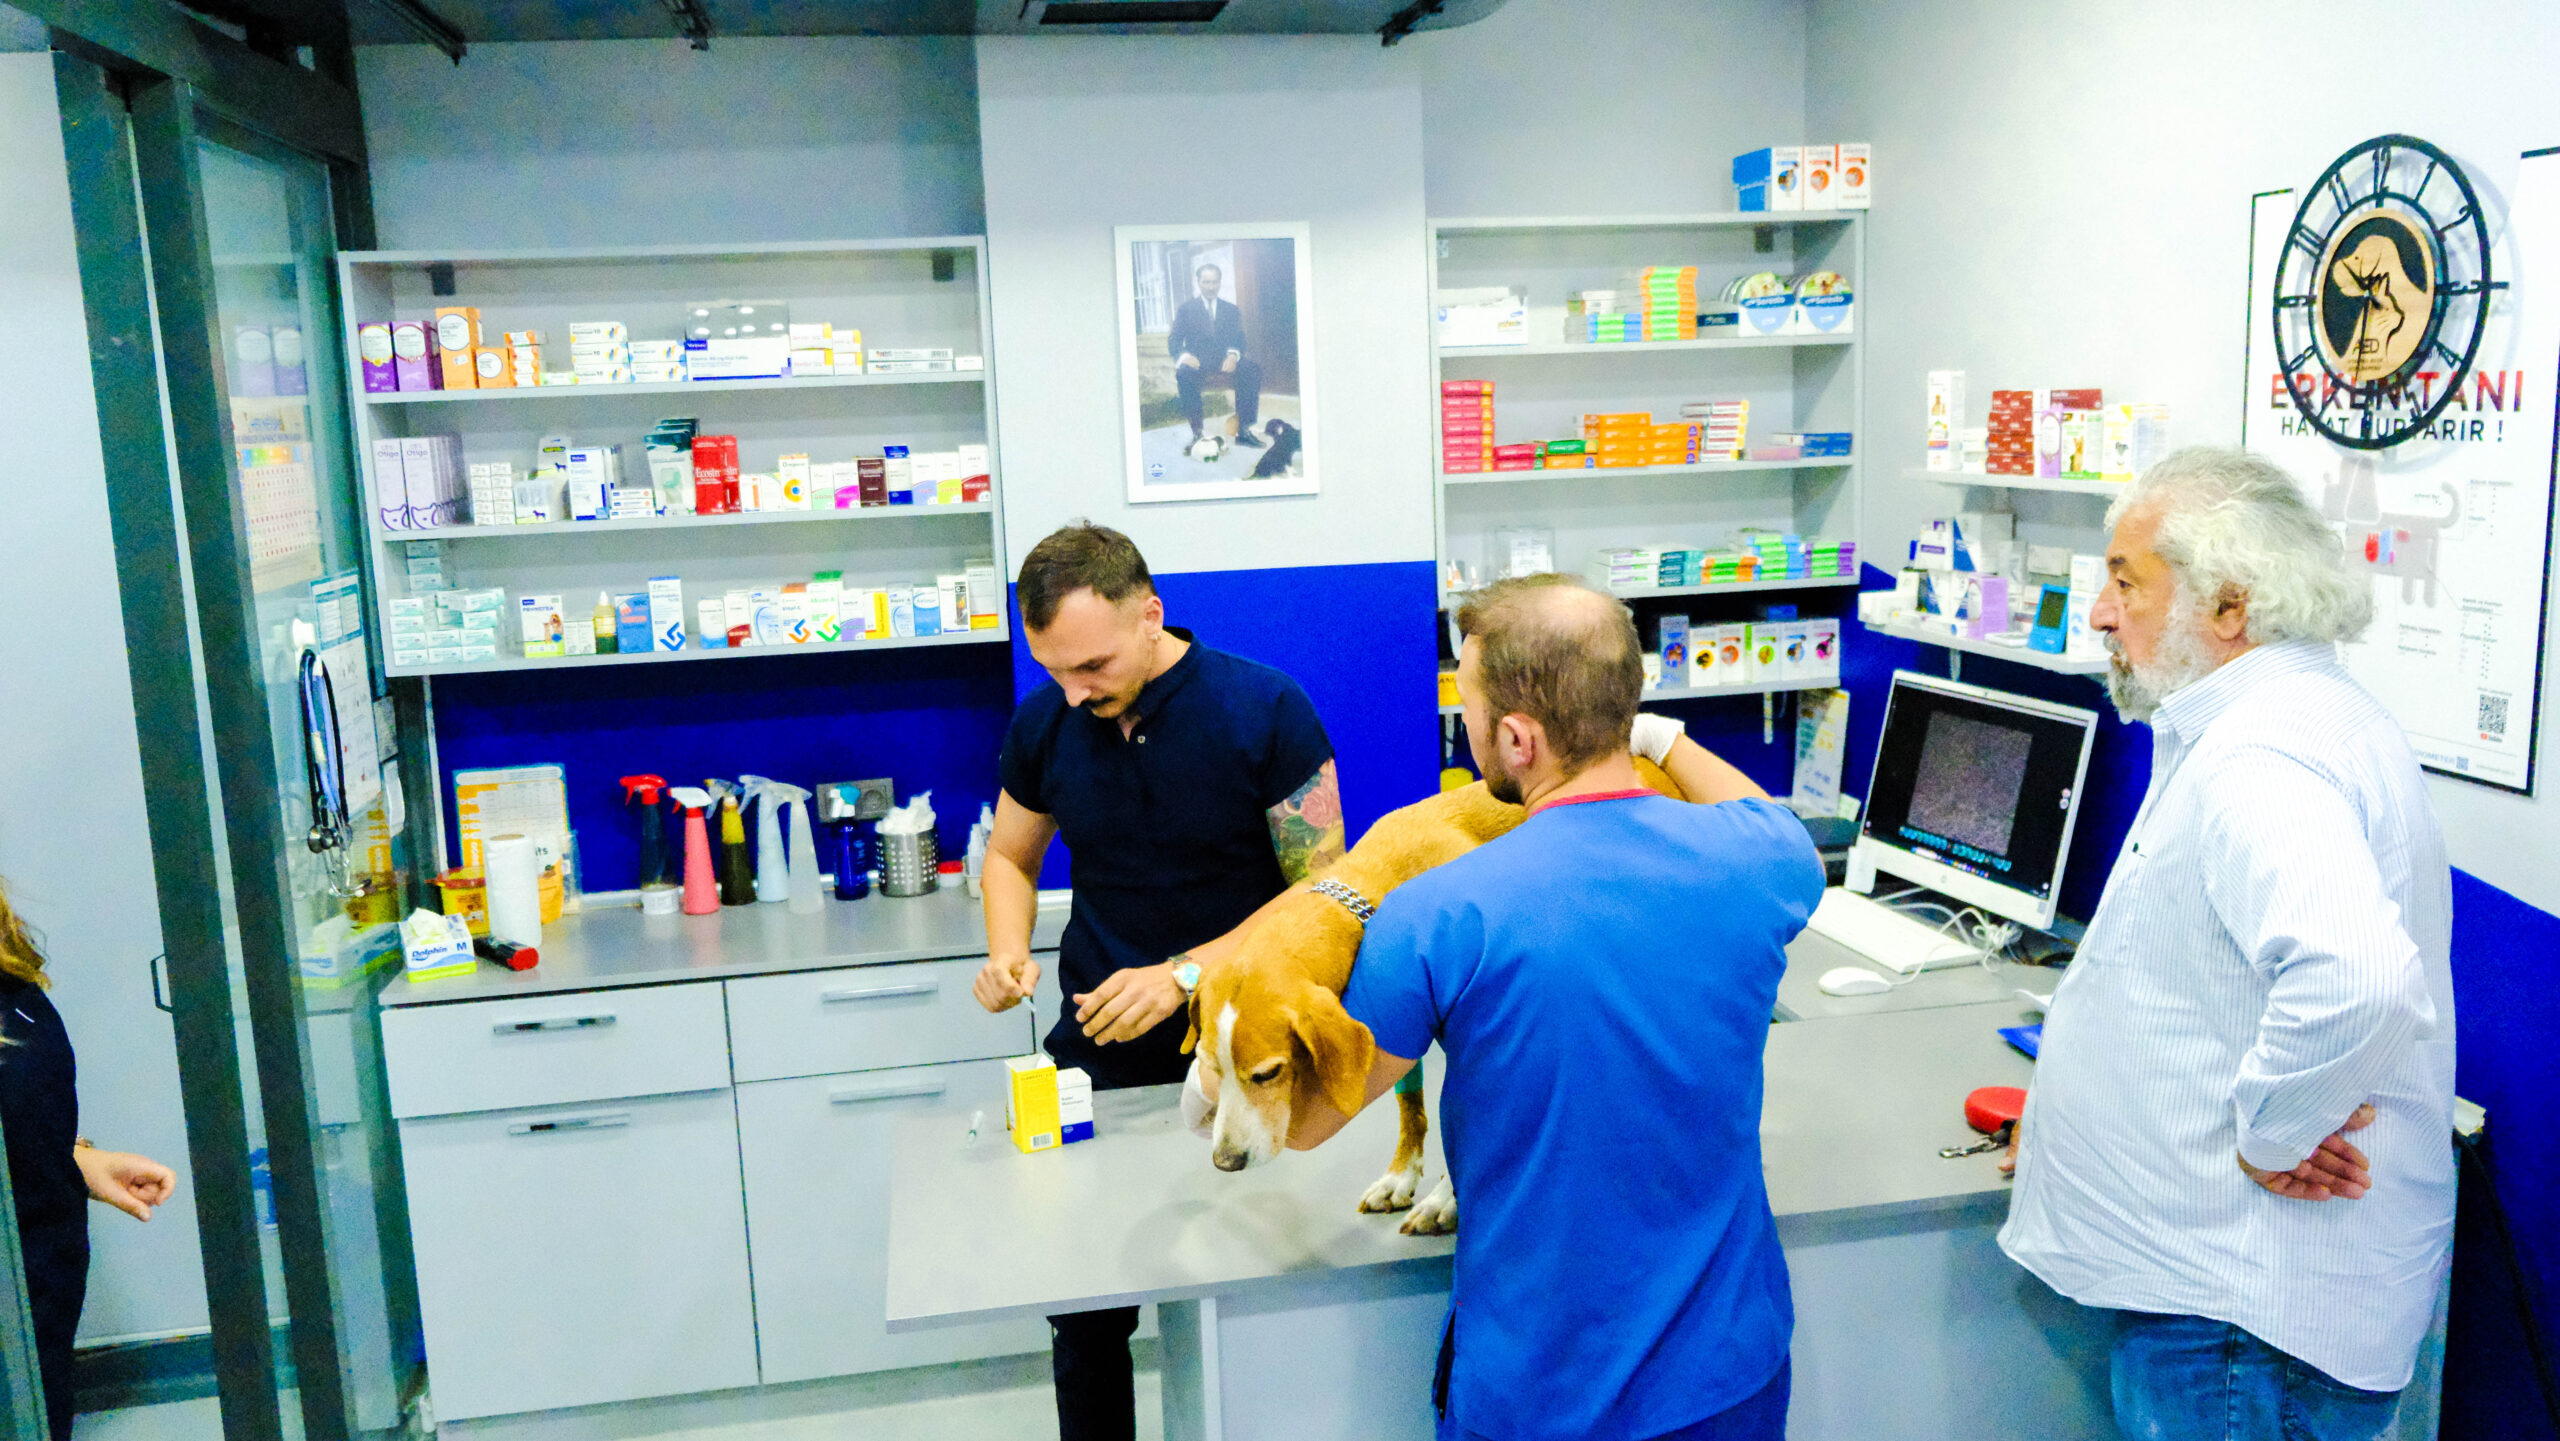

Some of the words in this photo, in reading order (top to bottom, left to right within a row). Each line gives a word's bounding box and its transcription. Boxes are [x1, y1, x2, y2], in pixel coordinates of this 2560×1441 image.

[2415, 370, 2524, 412] TANI
[2281, 416, 2350, 437] HAAT
[411, 946, 448, 958] Dolphin
[456, 941, 467, 952] M
